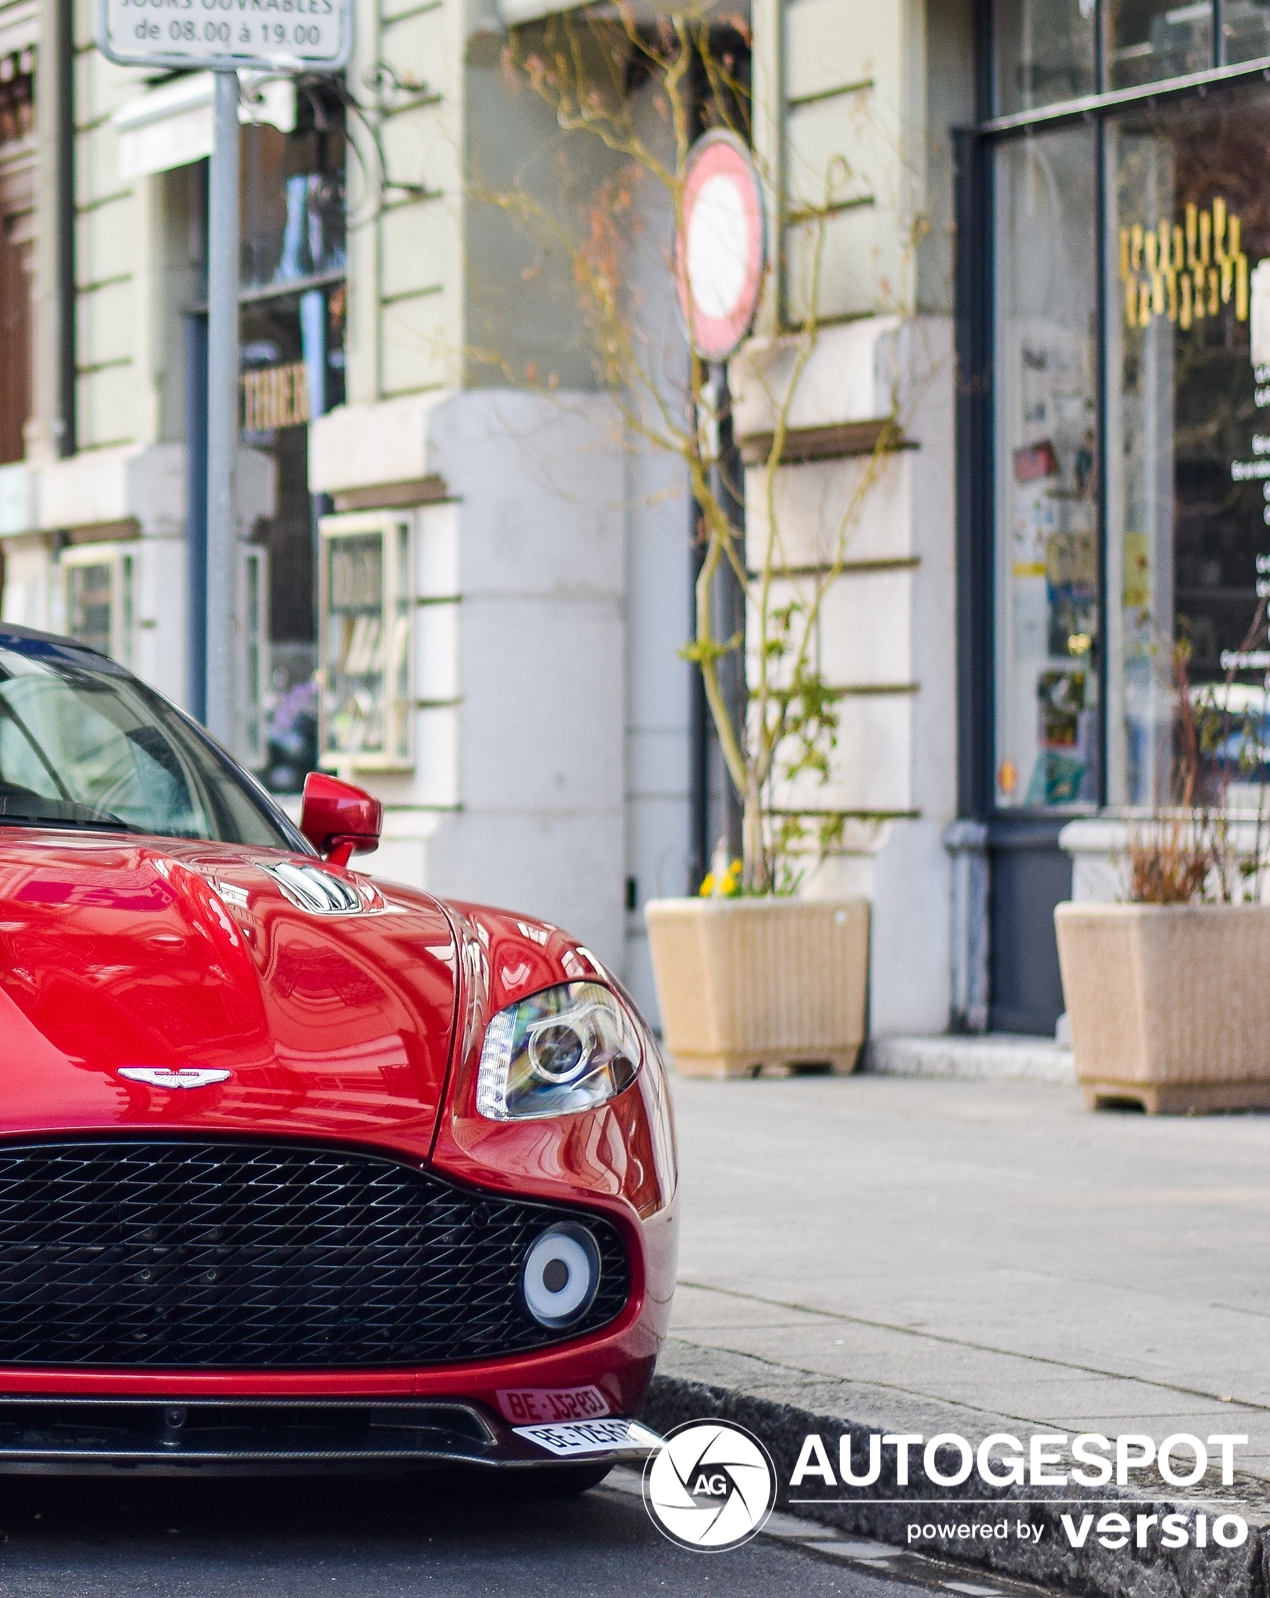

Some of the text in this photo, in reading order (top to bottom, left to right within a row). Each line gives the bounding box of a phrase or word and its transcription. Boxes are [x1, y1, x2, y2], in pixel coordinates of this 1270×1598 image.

[134, 18, 321, 45] de 08.00 à 19.00
